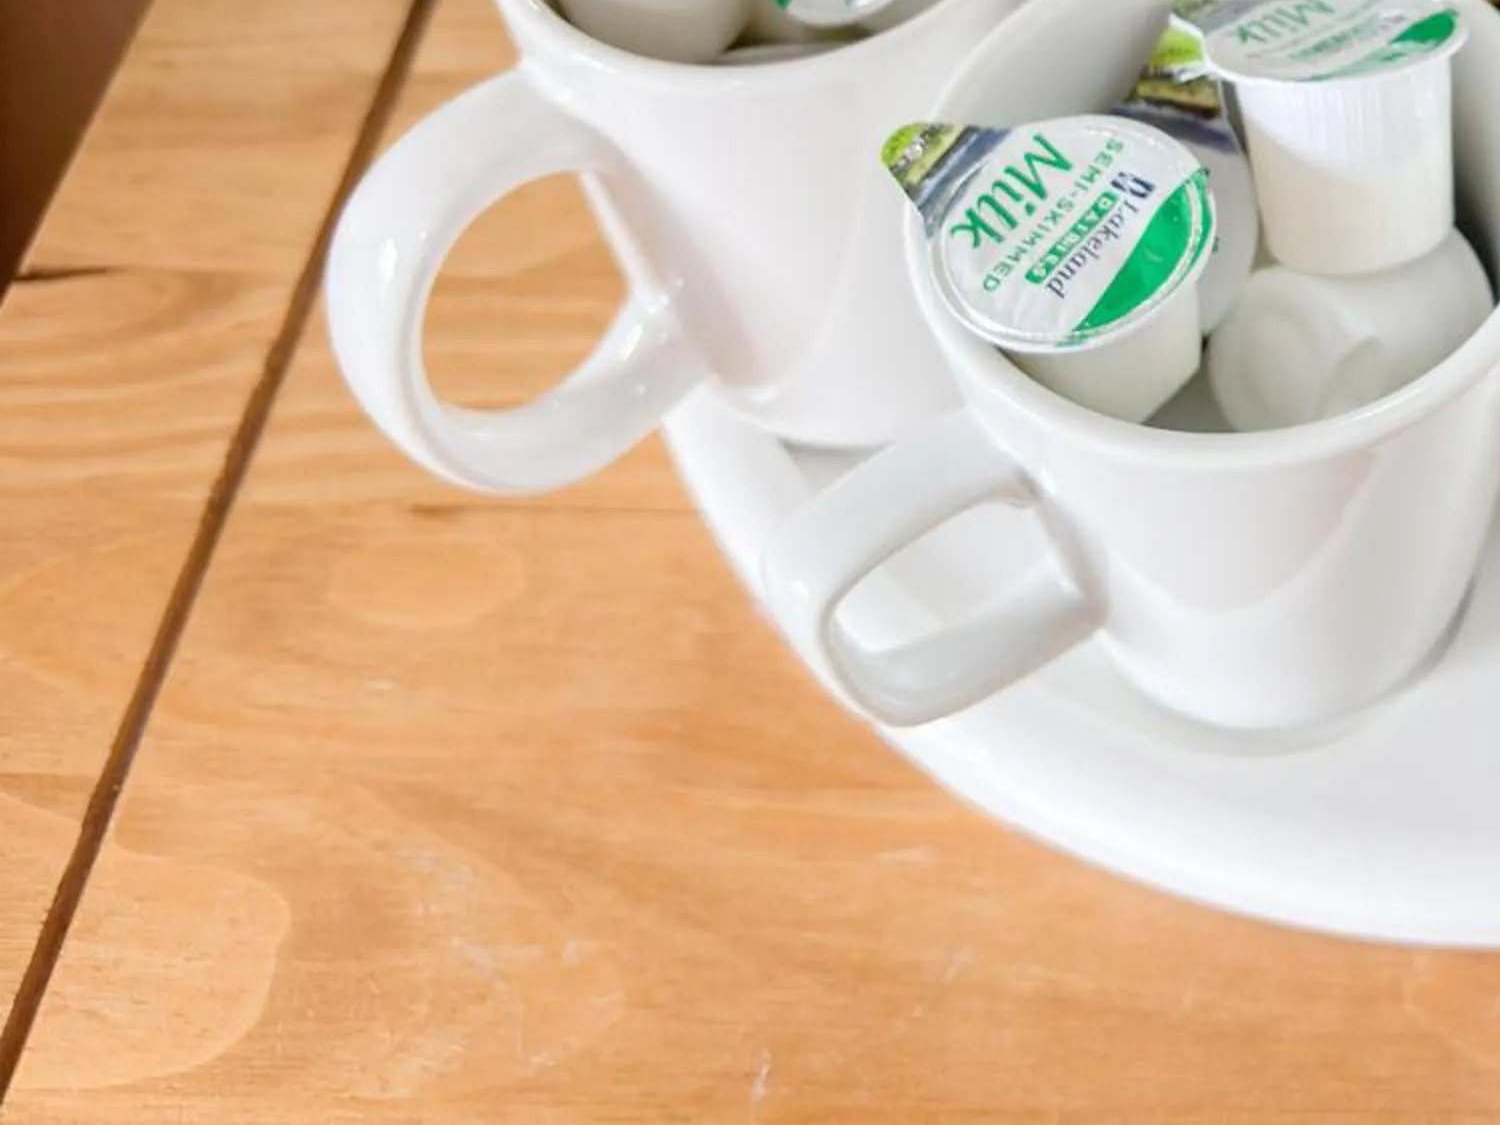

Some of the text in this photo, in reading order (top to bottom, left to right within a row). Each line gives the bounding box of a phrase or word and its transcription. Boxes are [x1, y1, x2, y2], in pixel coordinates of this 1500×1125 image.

[950, 132, 1073, 249] Milk
[982, 137, 1125, 293] SEMI-SKIMMED
[1045, 200, 1140, 299] Lakeland
